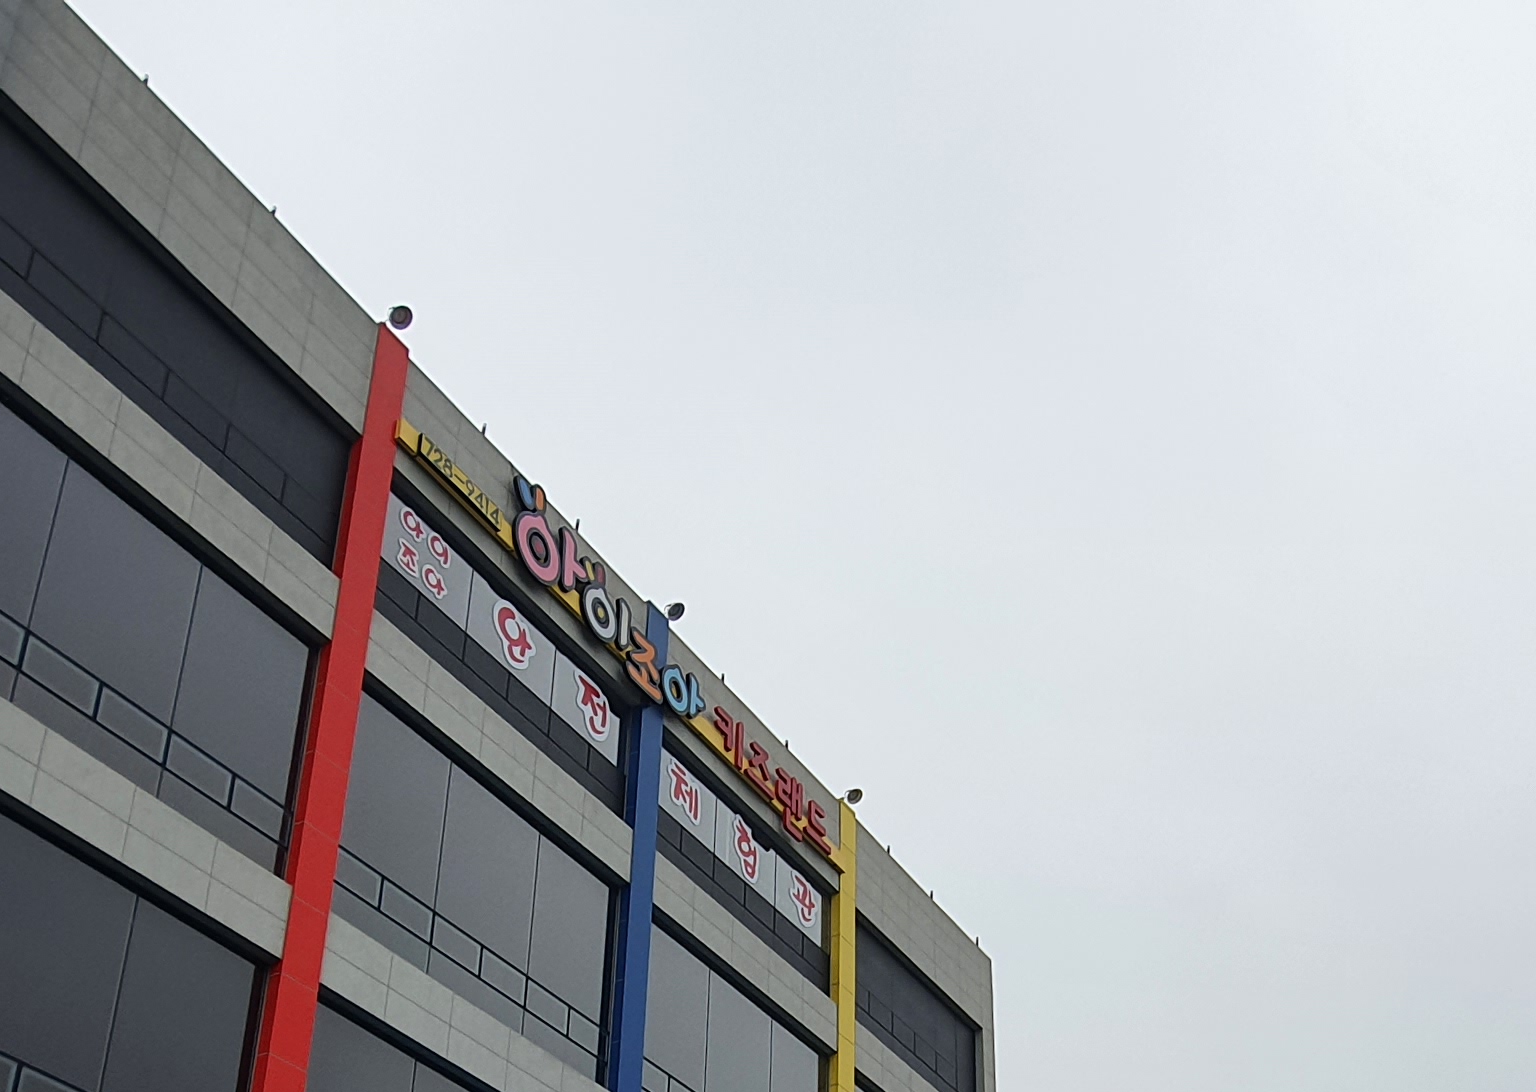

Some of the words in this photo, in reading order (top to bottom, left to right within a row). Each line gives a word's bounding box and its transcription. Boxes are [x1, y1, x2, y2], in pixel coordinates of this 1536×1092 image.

[423, 435, 500, 526] 728-9414
[513, 476, 706, 719] 아이조아
[714, 706, 831, 855] 키즈랜드
